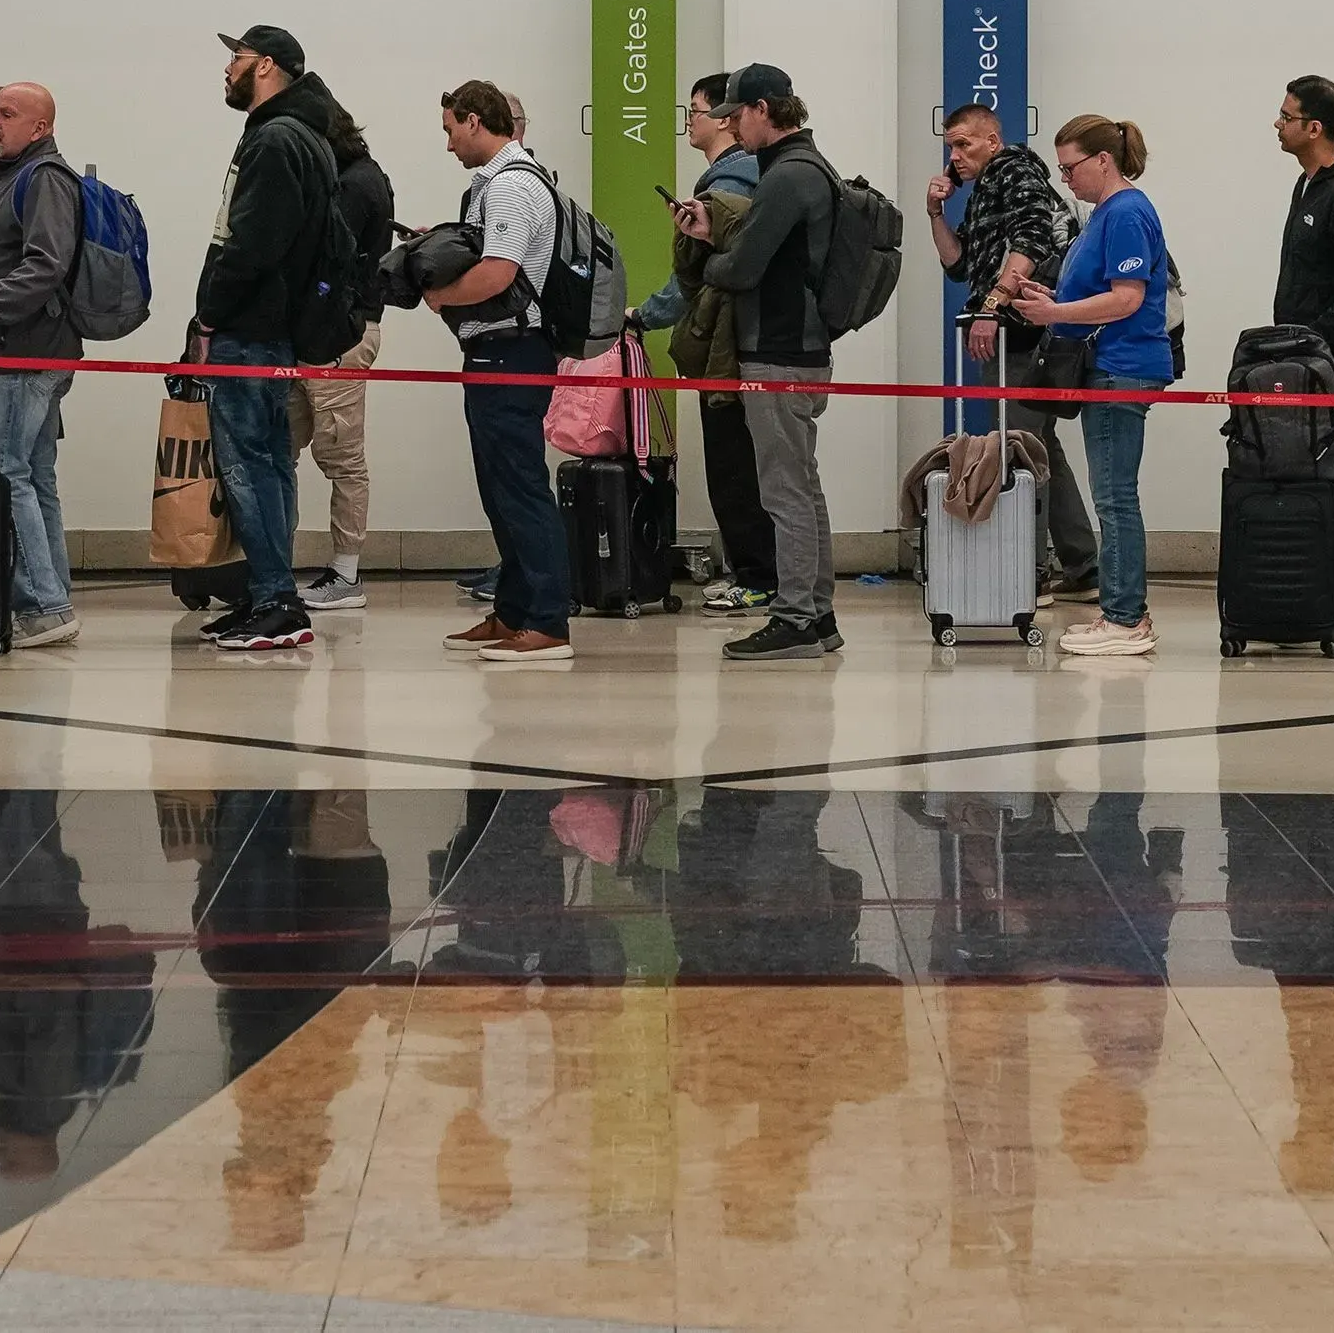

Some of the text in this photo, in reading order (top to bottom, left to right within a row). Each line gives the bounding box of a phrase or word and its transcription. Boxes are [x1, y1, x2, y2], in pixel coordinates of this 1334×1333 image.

[623, 7, 647, 145] All Gates
[273, 367, 303, 377] ATL
[739, 382, 768, 392] ATL
[1204, 393, 1234, 404] ATL
